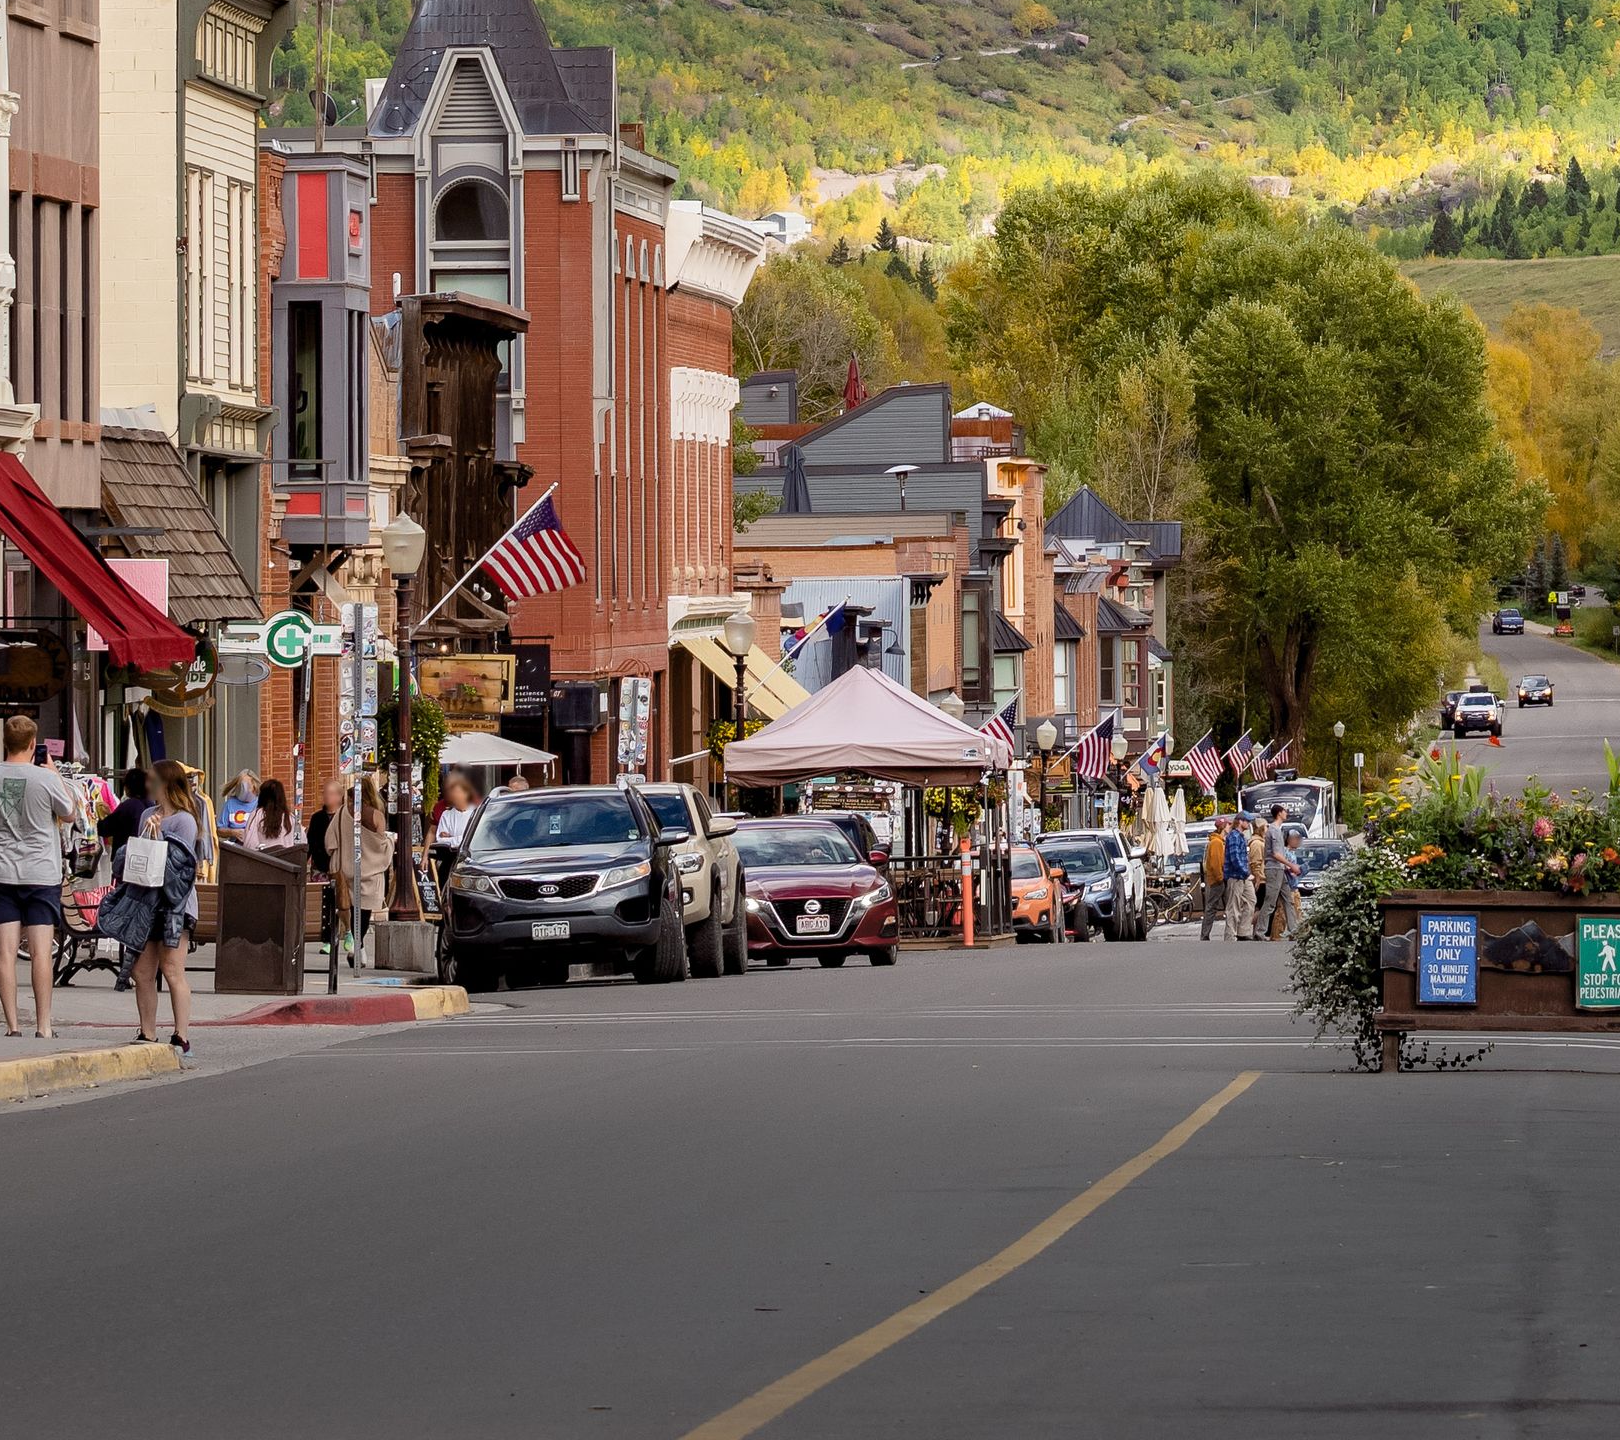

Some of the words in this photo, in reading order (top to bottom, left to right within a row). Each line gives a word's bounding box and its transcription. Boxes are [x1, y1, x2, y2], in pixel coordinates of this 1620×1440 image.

[543, 885, 555, 893] KIA
[1428, 921, 1471, 933] PARKING
[1422, 934, 1435, 946] BY
[1439, 935, 1476, 947] PERMIT
[1436, 948, 1462, 960] ONLY
[1427, 964, 1439, 974] 30
[1441, 964, 1469, 974] MINUTE
[1430, 975, 1467, 984] MAXIMUM
[1583, 973, 1608, 985] STOP
[1432, 988, 1445, 996] TOW
[1447, 988, 1464, 996] AWAY
